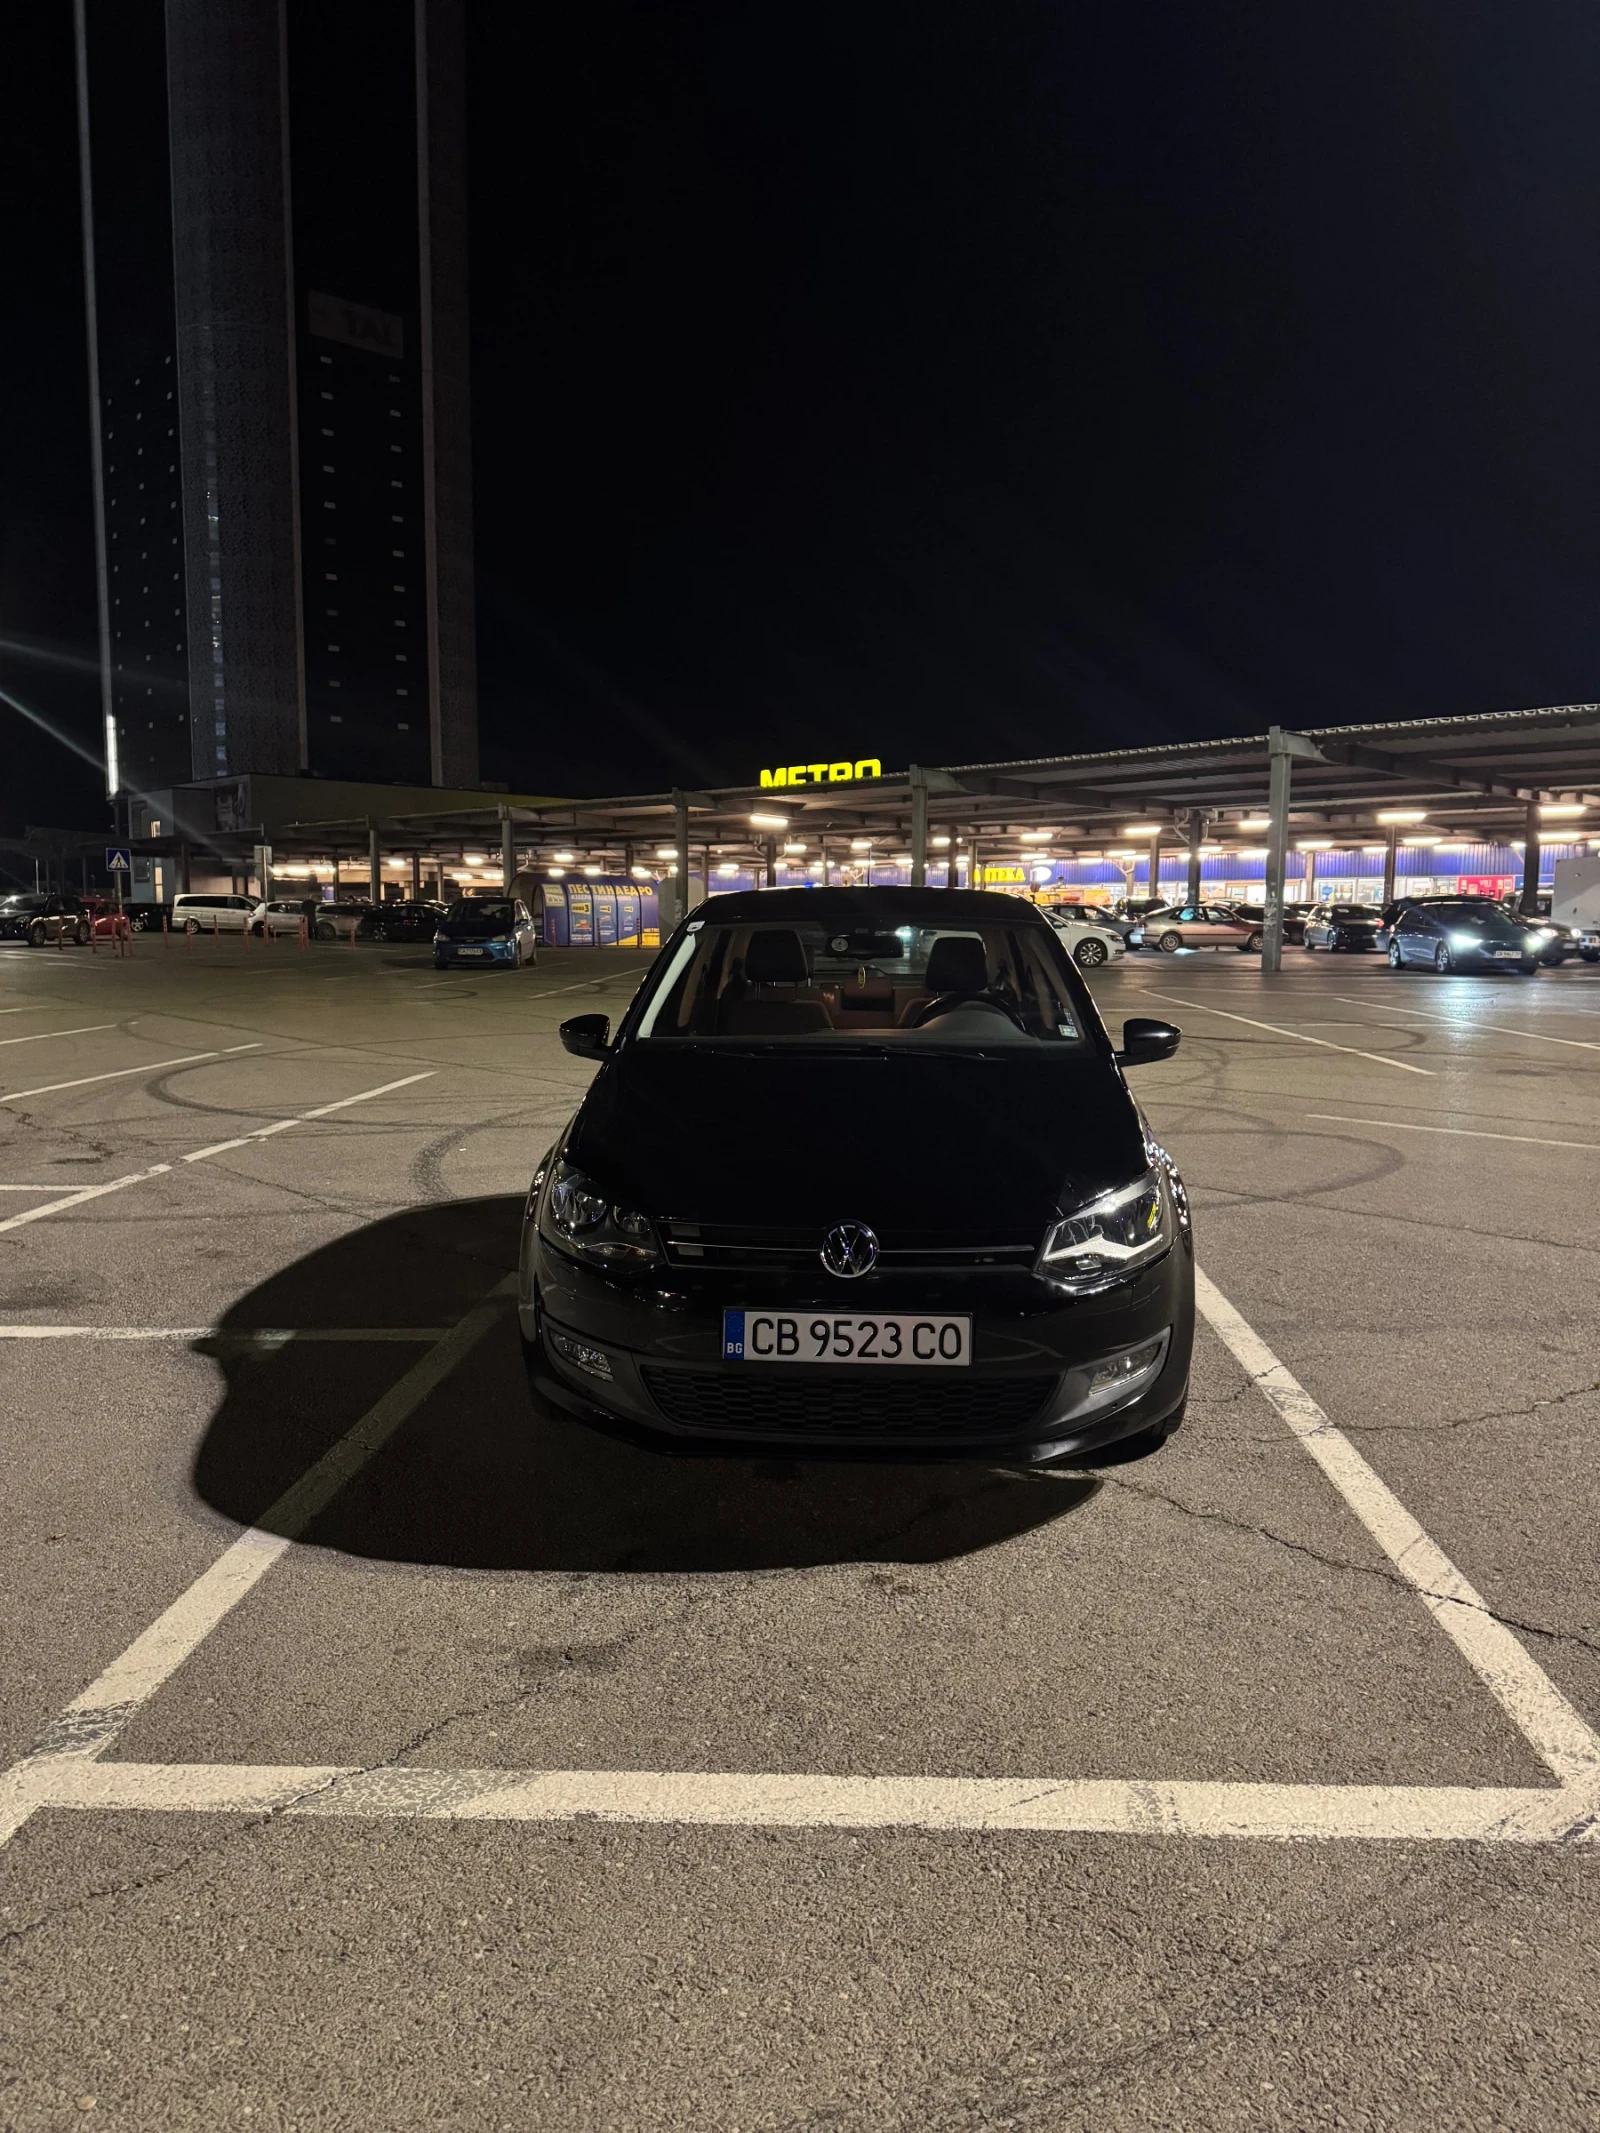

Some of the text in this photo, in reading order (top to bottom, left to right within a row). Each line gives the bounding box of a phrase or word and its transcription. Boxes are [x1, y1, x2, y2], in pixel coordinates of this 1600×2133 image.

[760, 759, 881, 788] METRO
[726, 1342, 743, 1354] BG
[751, 1318, 962, 1360] CB 9523 CO
